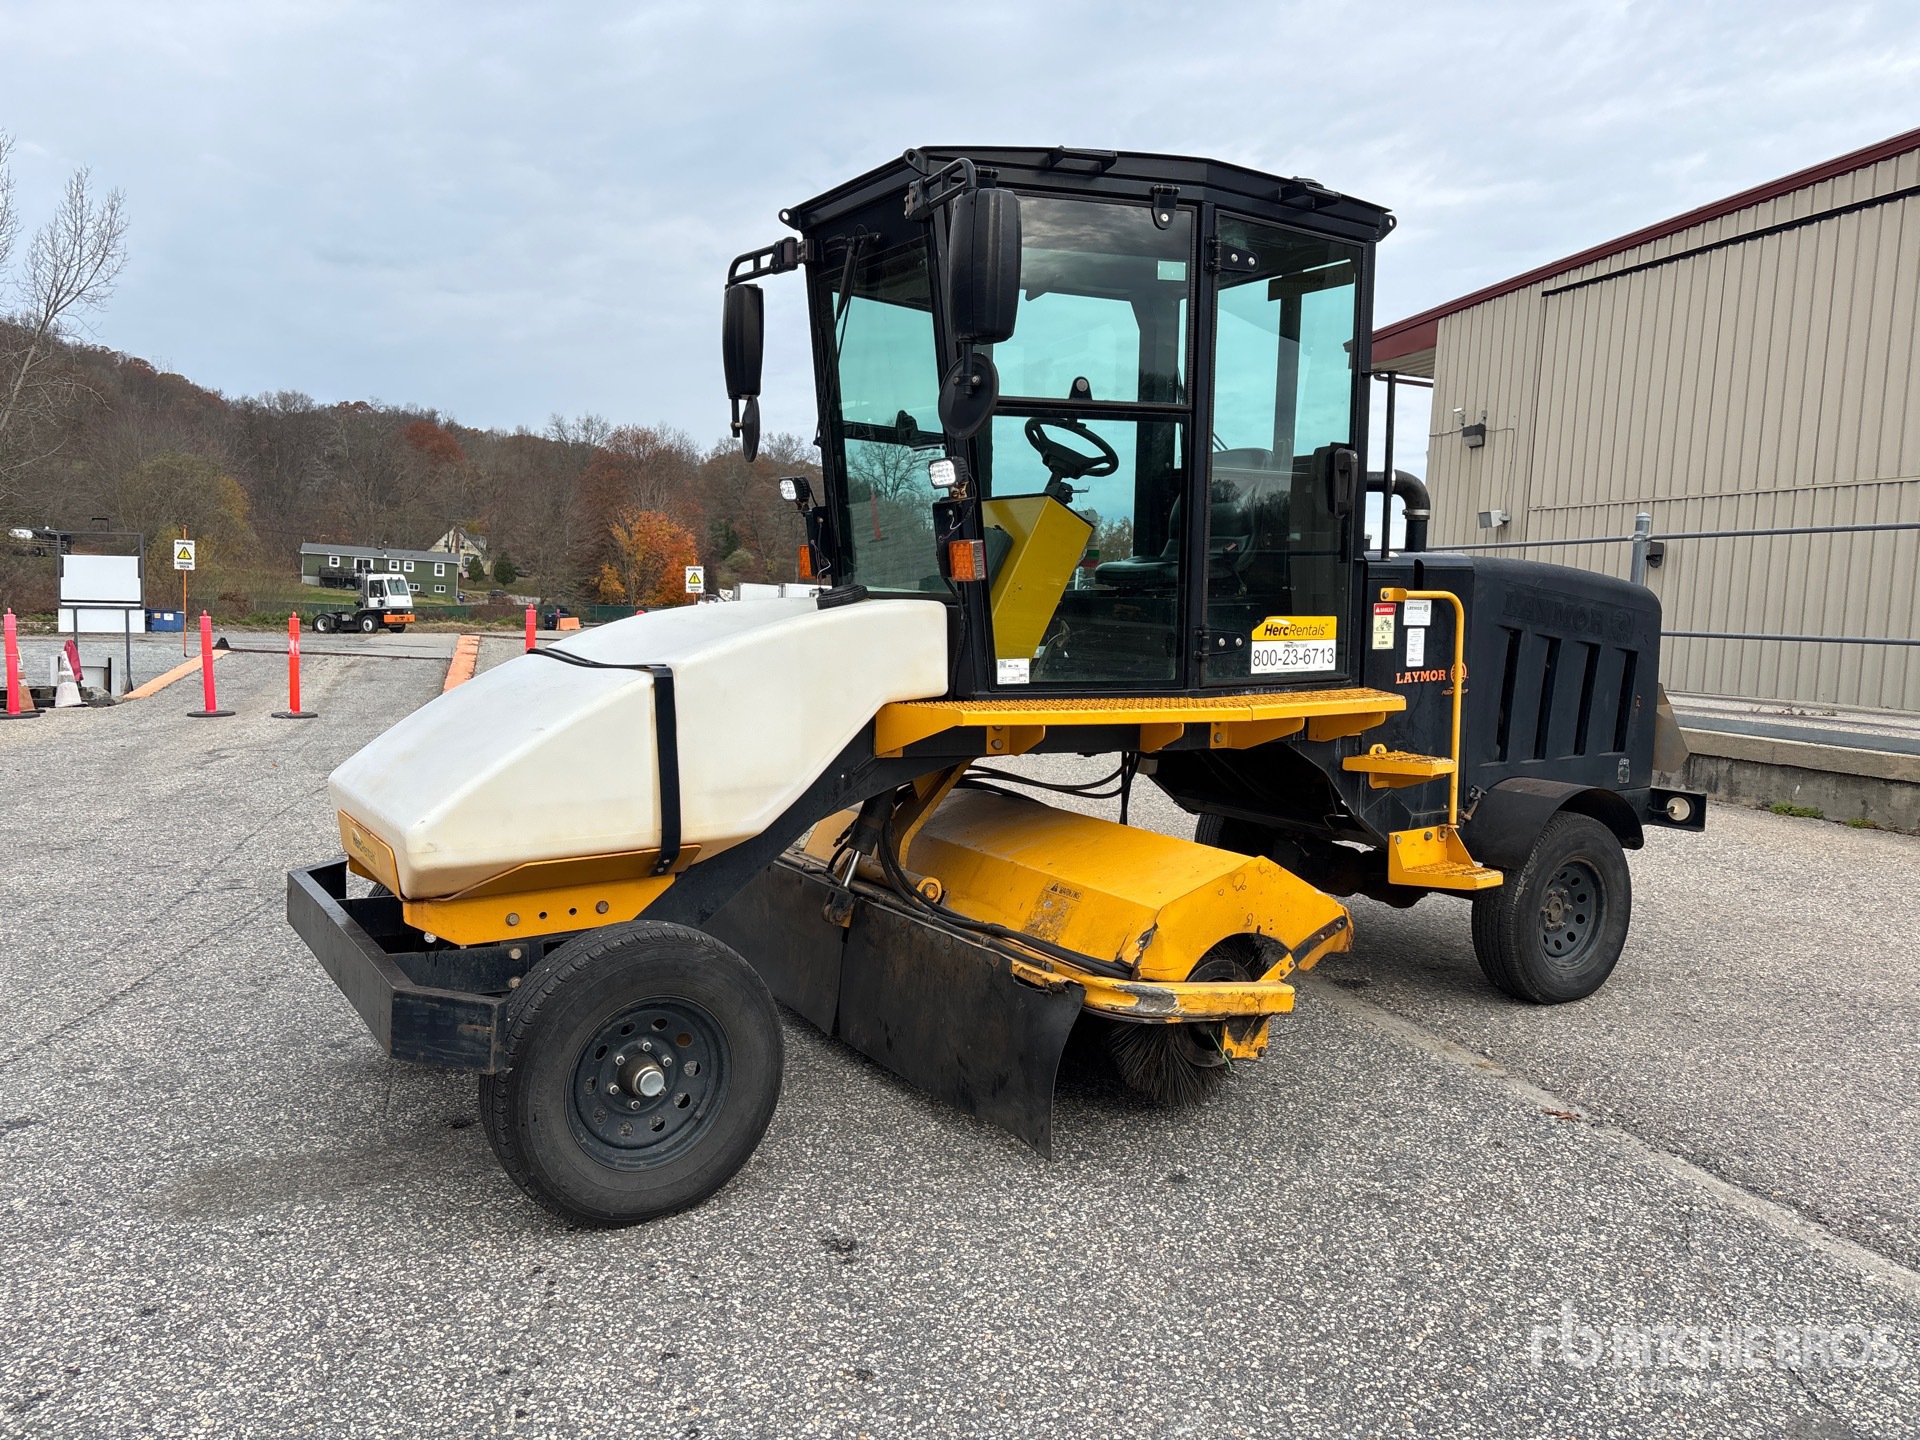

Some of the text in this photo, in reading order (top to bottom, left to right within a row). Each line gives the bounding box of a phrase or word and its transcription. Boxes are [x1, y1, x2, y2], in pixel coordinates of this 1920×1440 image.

[1503, 590, 1603, 634] LAYMOR
[1264, 624, 1326, 637] HercRentals
[1253, 648, 1334, 667] 800-23-6713
[1395, 669, 1446, 684] LAYMOR
